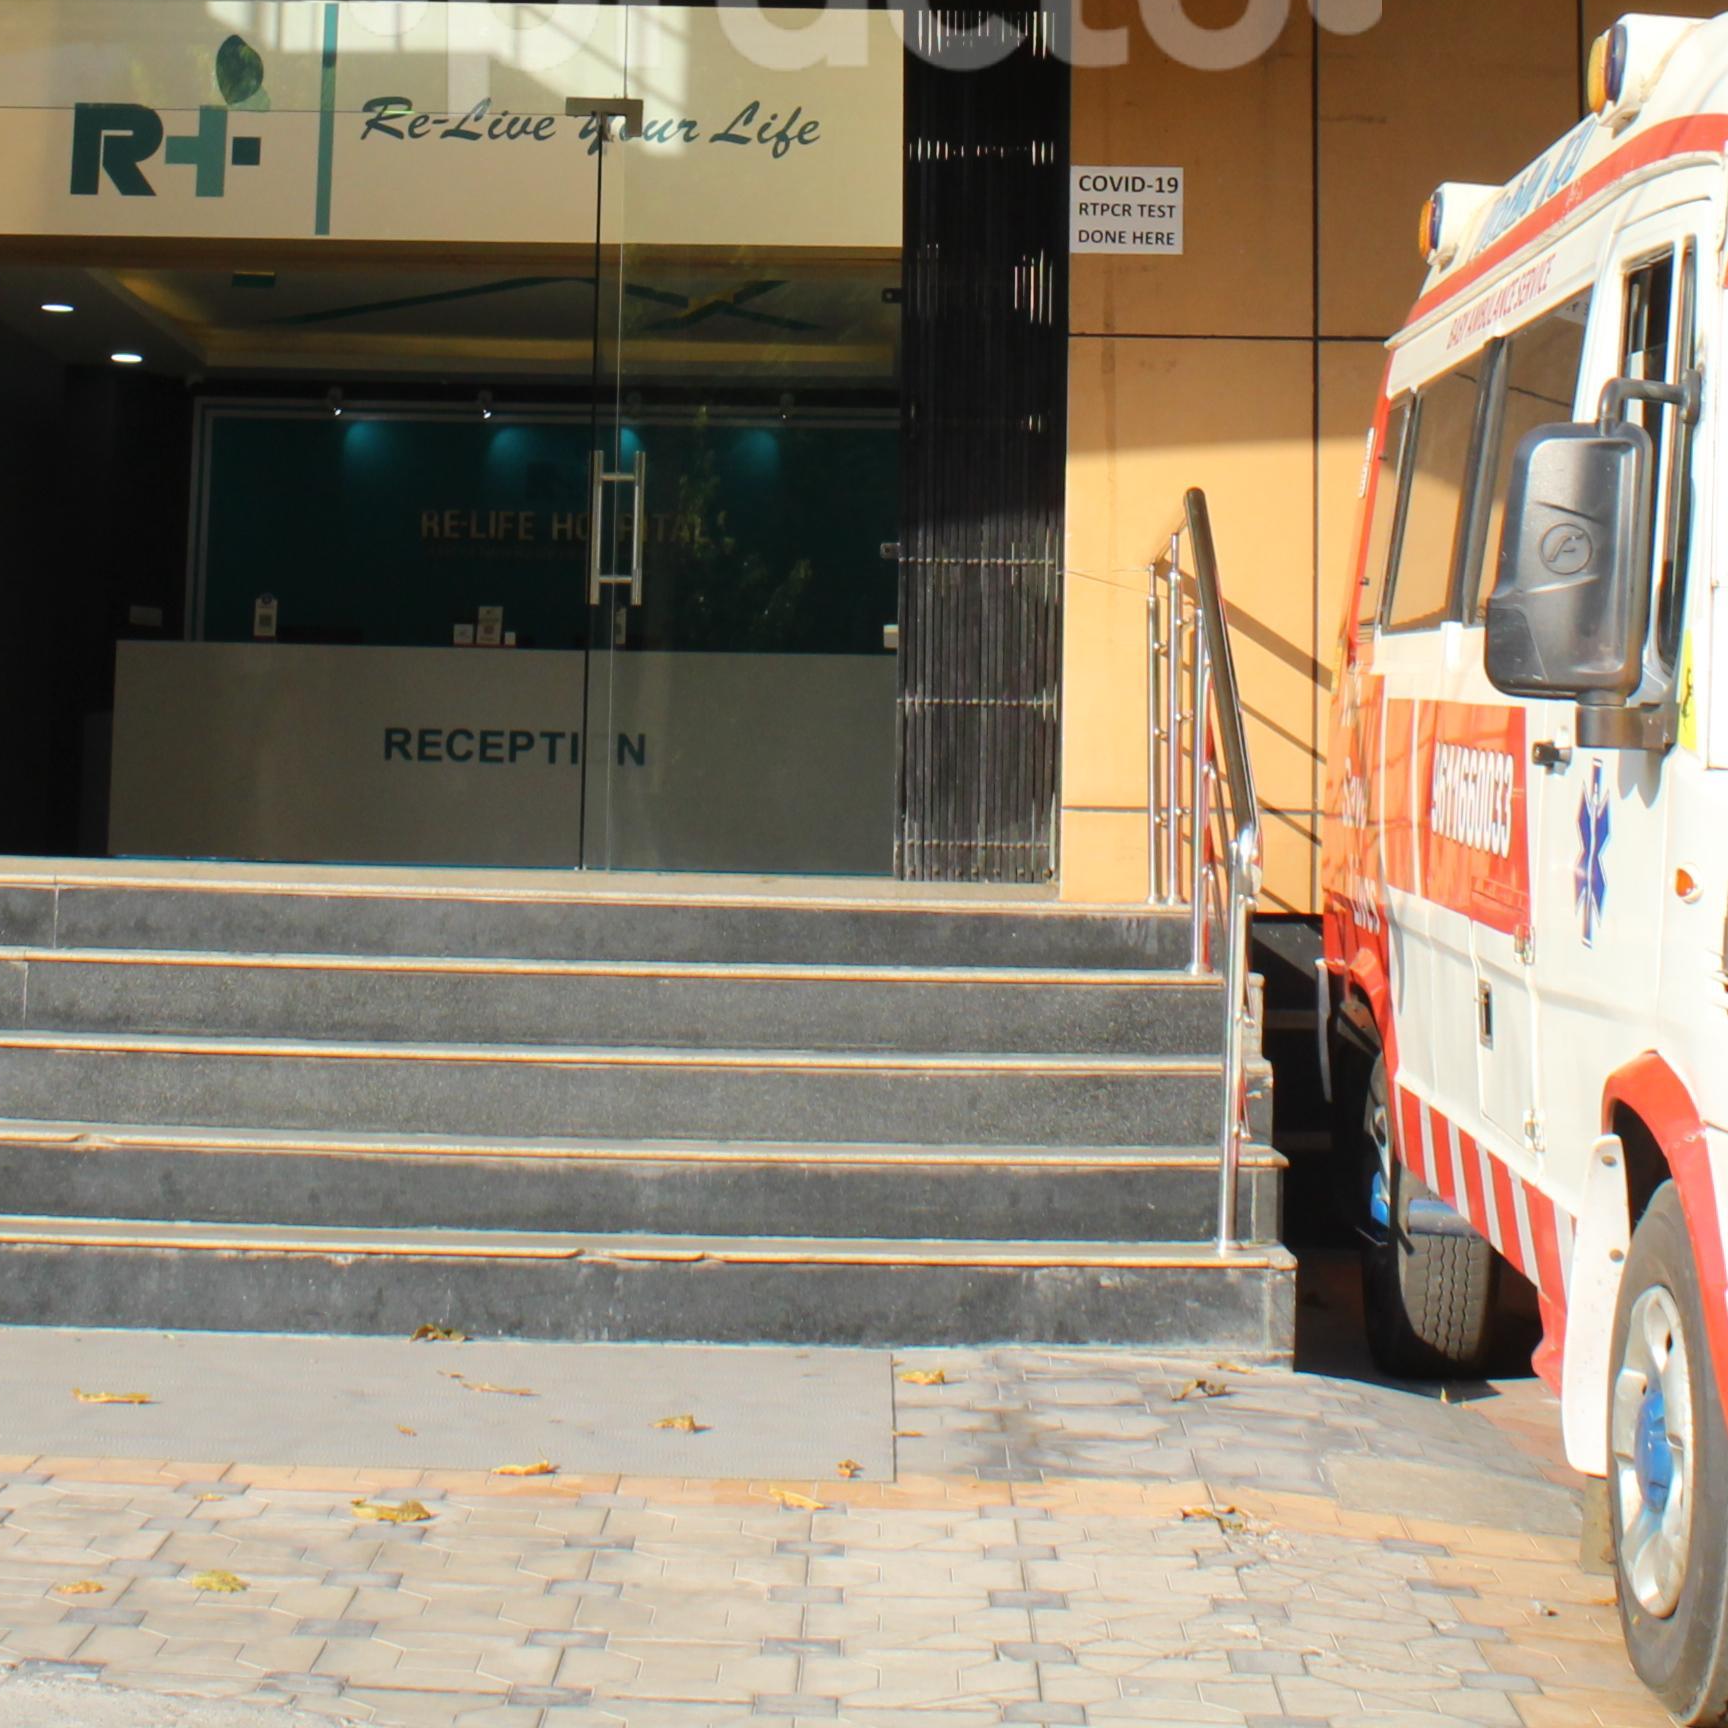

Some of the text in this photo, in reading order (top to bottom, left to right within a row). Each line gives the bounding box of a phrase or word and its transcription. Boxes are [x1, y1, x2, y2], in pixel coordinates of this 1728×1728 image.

[359, 95, 558, 143] Re-Live
[708, 98, 822, 159] Life
[1078, 174, 1179, 194] COVID-19
[1078, 202, 1177, 219] RTPCR TEST
[1078, 229, 1176, 246] DONE HERE
[383, 727, 647, 767] RECEPTIN
